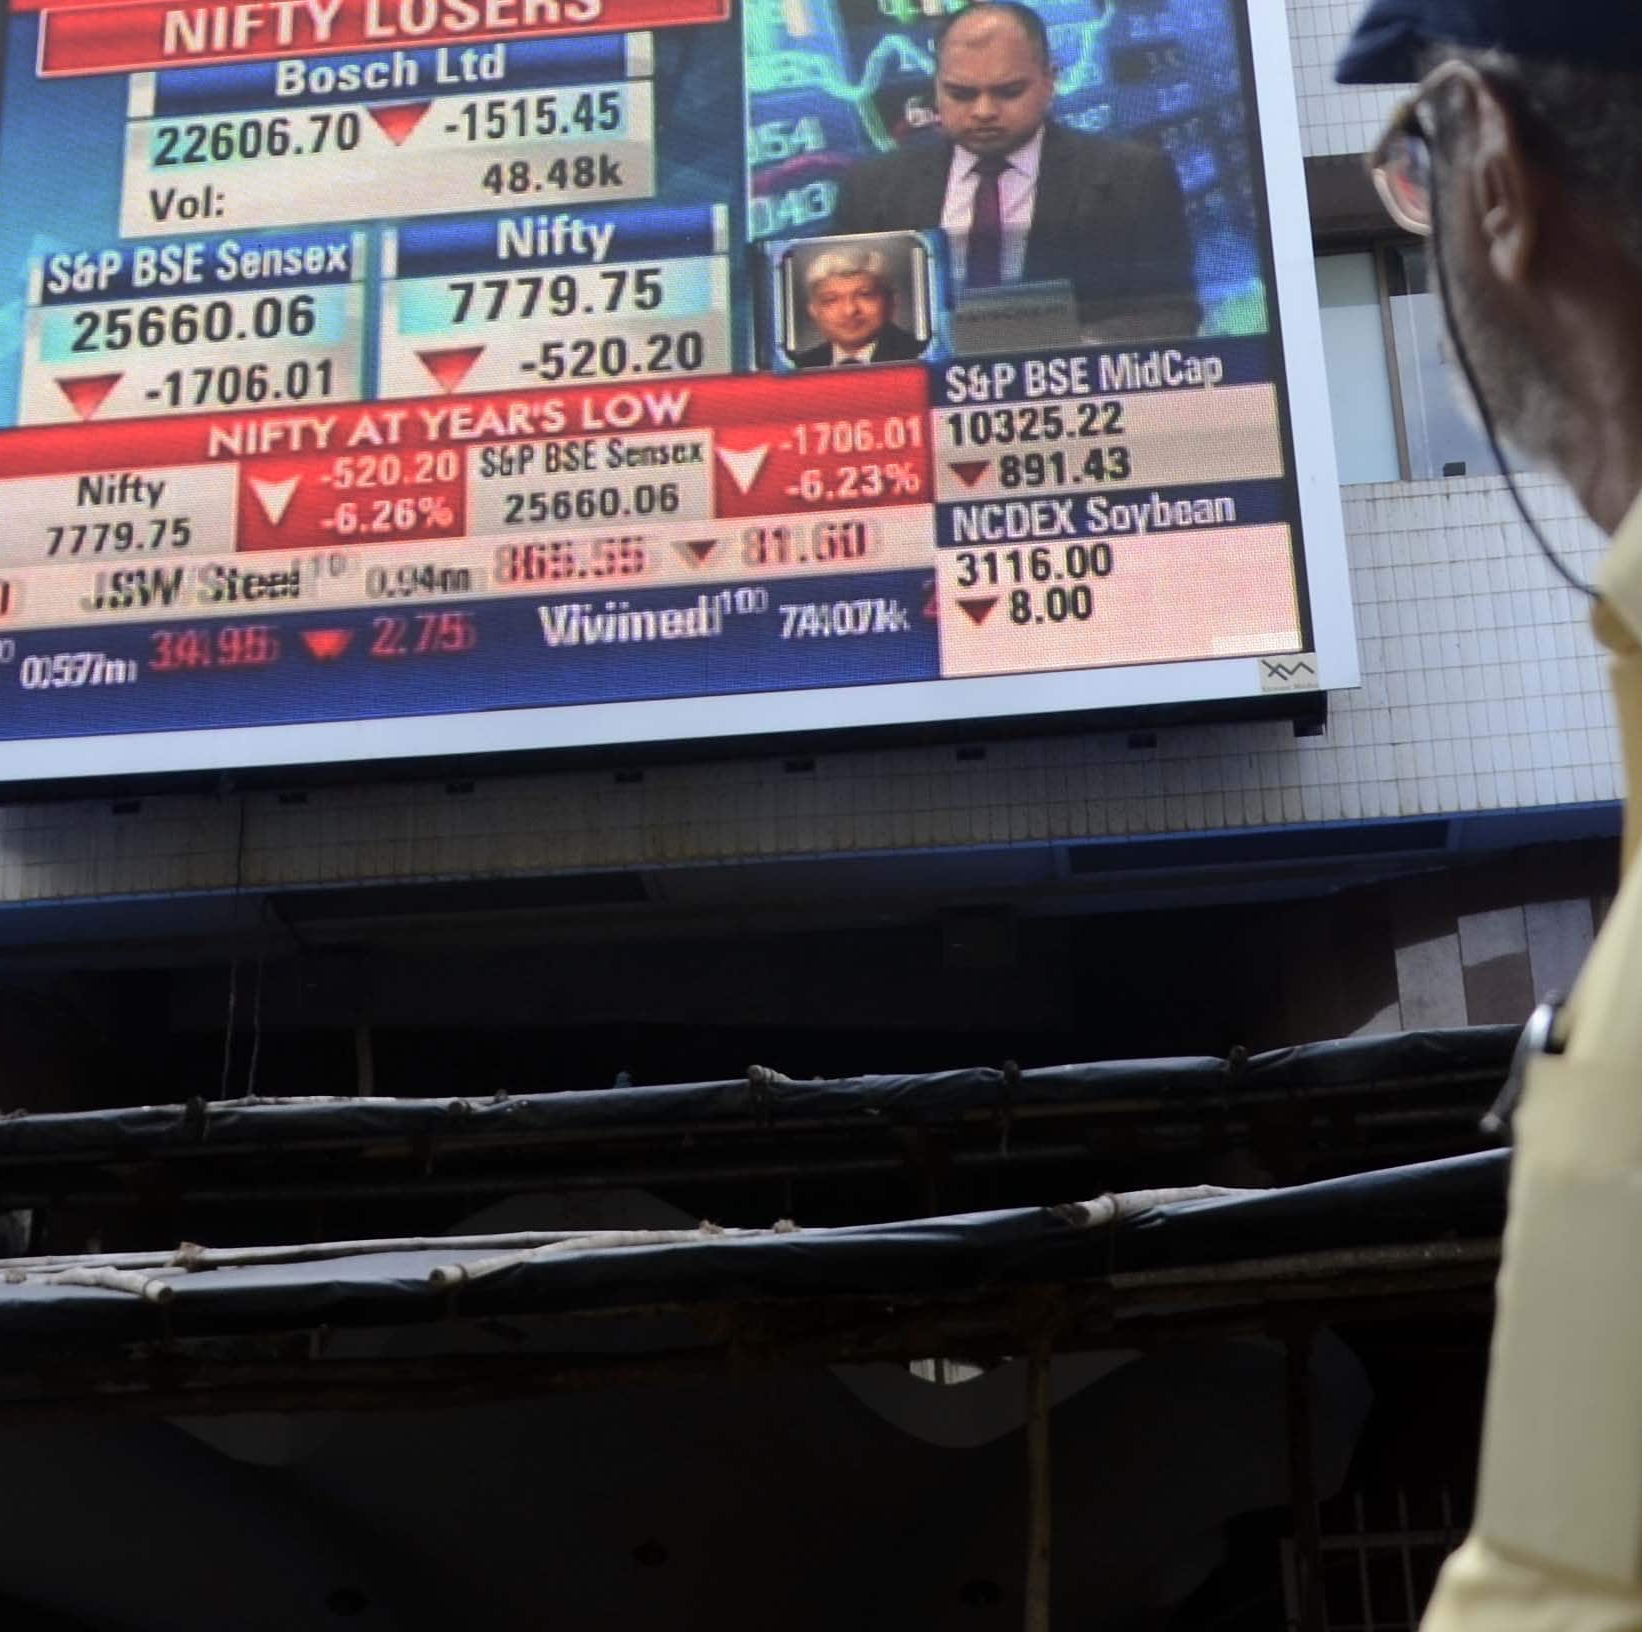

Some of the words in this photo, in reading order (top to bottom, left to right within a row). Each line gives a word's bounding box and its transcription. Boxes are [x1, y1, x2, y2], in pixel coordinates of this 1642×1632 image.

[275, 50, 419, 98] Bosch
[436, 42, 506, 84] Ltd
[153, 112, 360, 167] 22606.70
[444, 91, 621, 142] -1515.45
[481, 153, 624, 195] 48.48k
[149, 186, 225, 222] Vol:
[496, 214, 615, 264] Nifty
[46, 250, 121, 294] S&P
[131, 242, 206, 288] BSE
[215, 238, 349, 281] Sensex
[448, 266, 663, 325] 7779.75
[70, 294, 317, 354] 25660.06
[519, 330, 704, 382] -520.20
[944, 365, 1015, 403] S&P
[1024, 356, 1091, 396] BSE
[1099, 349, 1223, 390] MidCap
[144, 358, 333, 407] -1706.01
[207, 416, 339, 458] NIFTY
[347, 409, 408, 448] AT
[419, 396, 566, 442] YEAR'S
[581, 389, 693, 431] LOW
[778, 415, 923, 456] -1706.01
[948, 399, 1126, 446] 10325.22
[321, 448, 459, 490] -520.20
[479, 443, 536, 479] S&P
[544, 440, 600, 474] BSE
[606, 437, 704, 469] Sensex
[999, 445, 1131, 488] 891.43
[75, 472, 167, 509] Nifty
[502, 482, 681, 524] 25660.06
[784, 462, 922, 502] -6.23%
[45, 516, 193, 557] 7779.75
[321, 496, 455, 535] -6.26%
[952, 498, 1076, 542] NCDEX
[1085, 492, 1237, 534] Soybean
[79, 567, 184, 611] JSW
[197, 558, 301, 603] Steel
[955, 542, 1114, 587] 3116.00
[1009, 584, 1094, 625] 8.00
